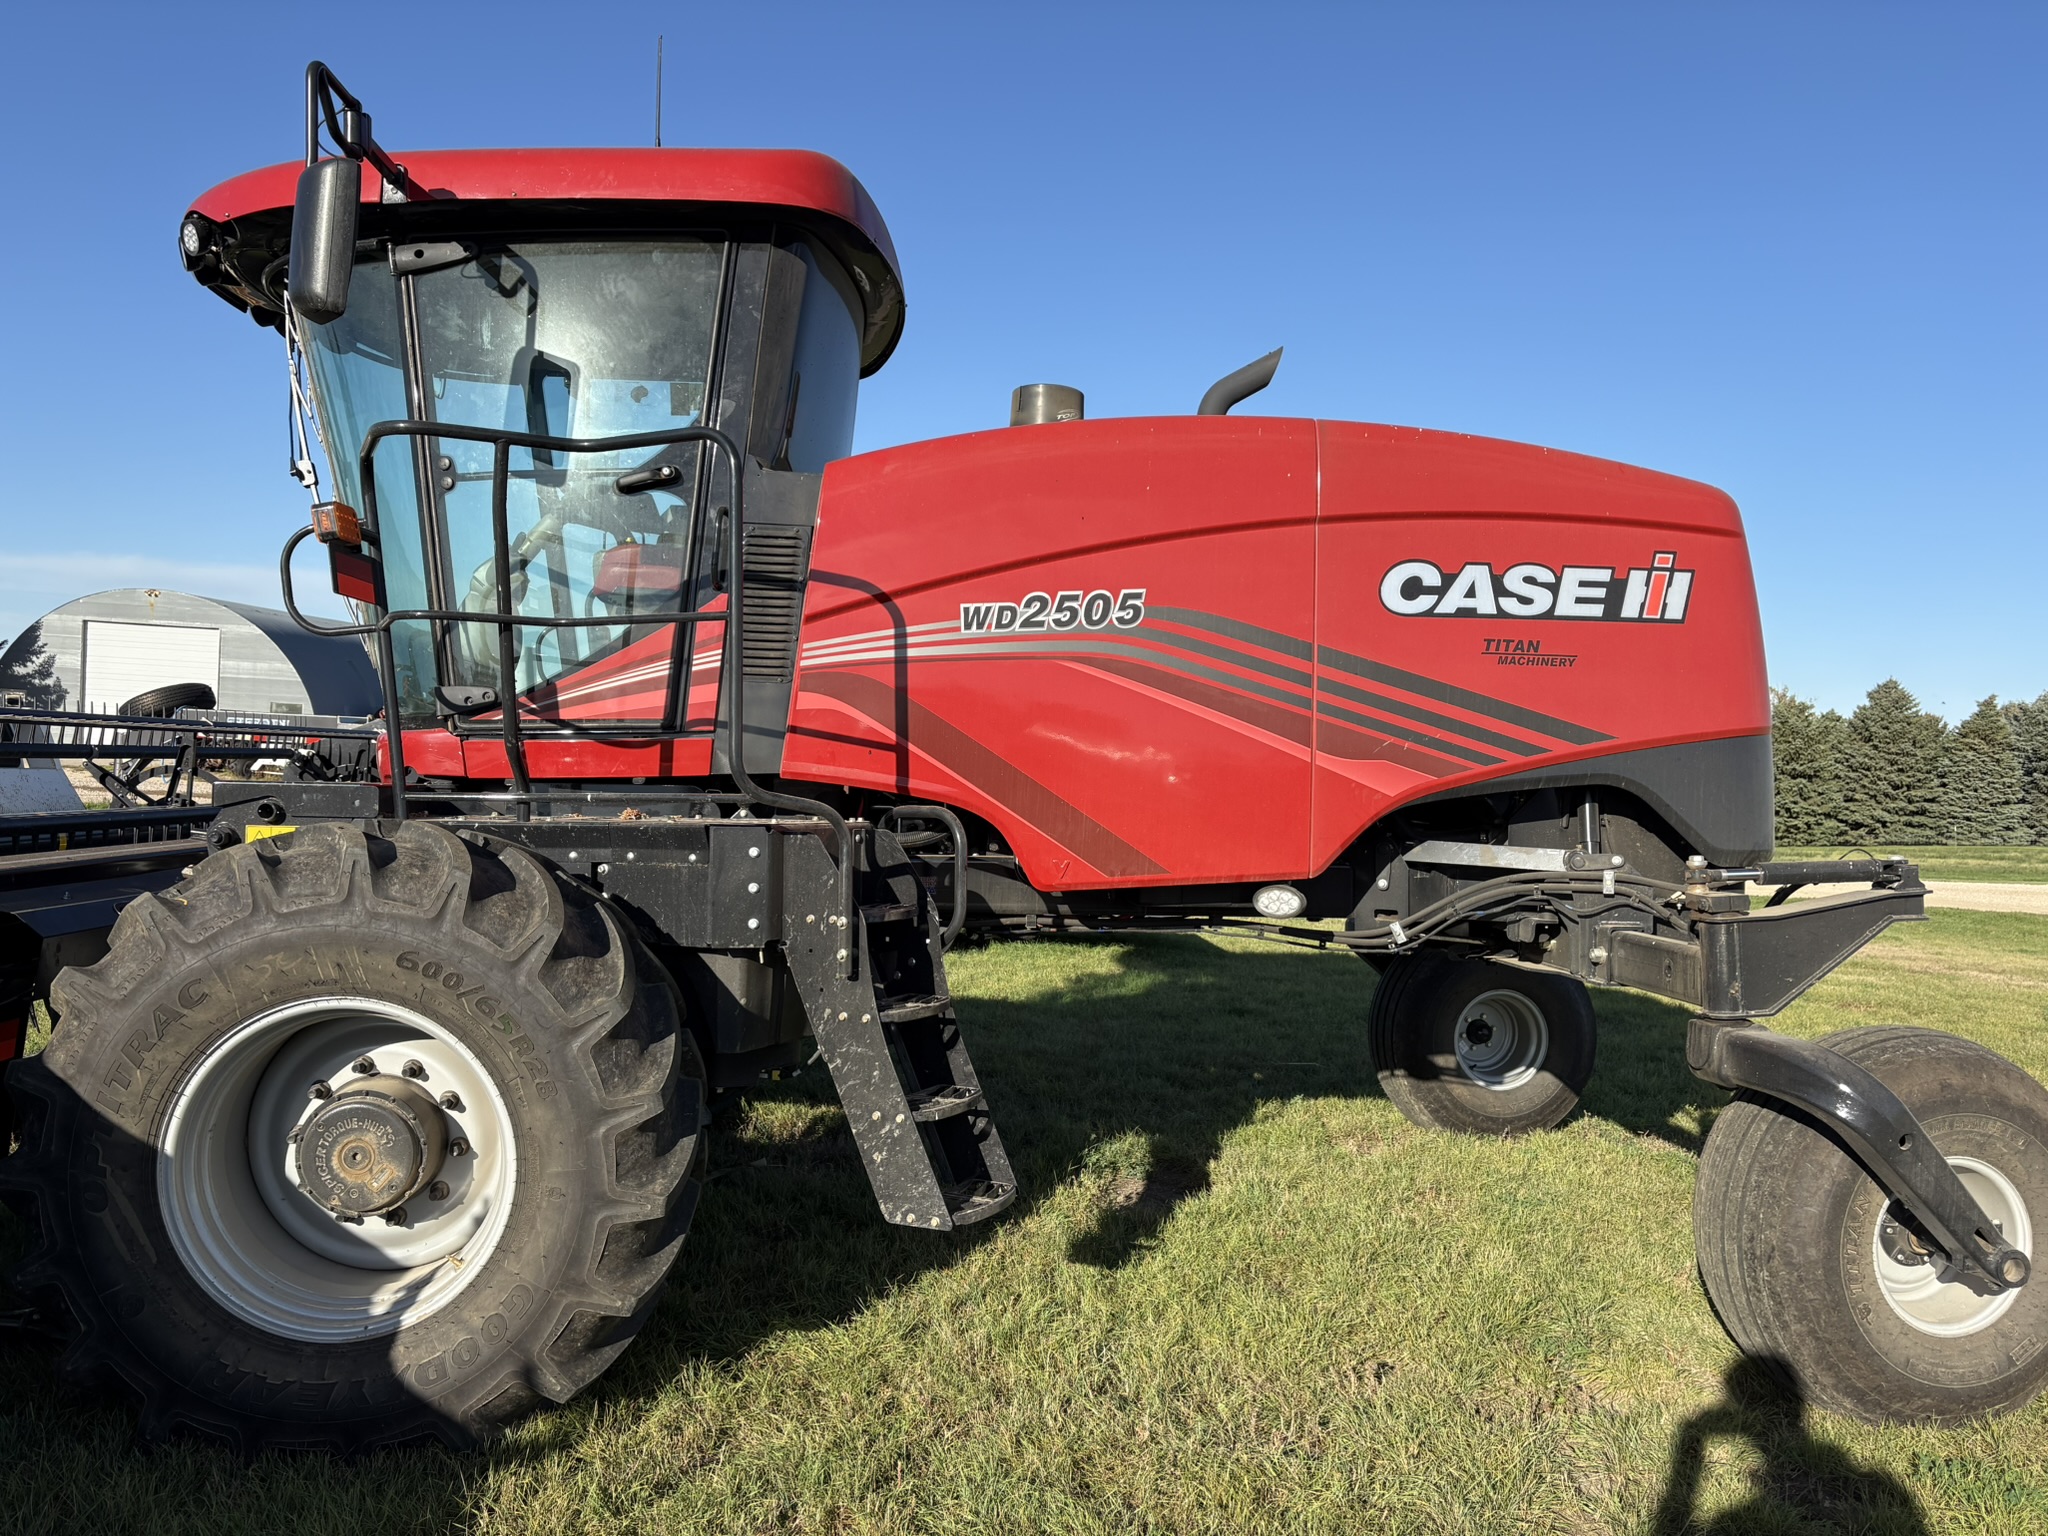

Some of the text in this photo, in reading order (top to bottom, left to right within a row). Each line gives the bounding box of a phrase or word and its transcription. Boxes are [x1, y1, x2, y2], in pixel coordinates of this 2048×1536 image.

[960, 588, 1146, 633] WD2505
[1380, 562, 1613, 617] CASE
[1483, 638, 1541, 653] TITAN
[1497, 655, 1576, 668] MACHINERY
[396, 951, 559, 1100] 600/65R28
